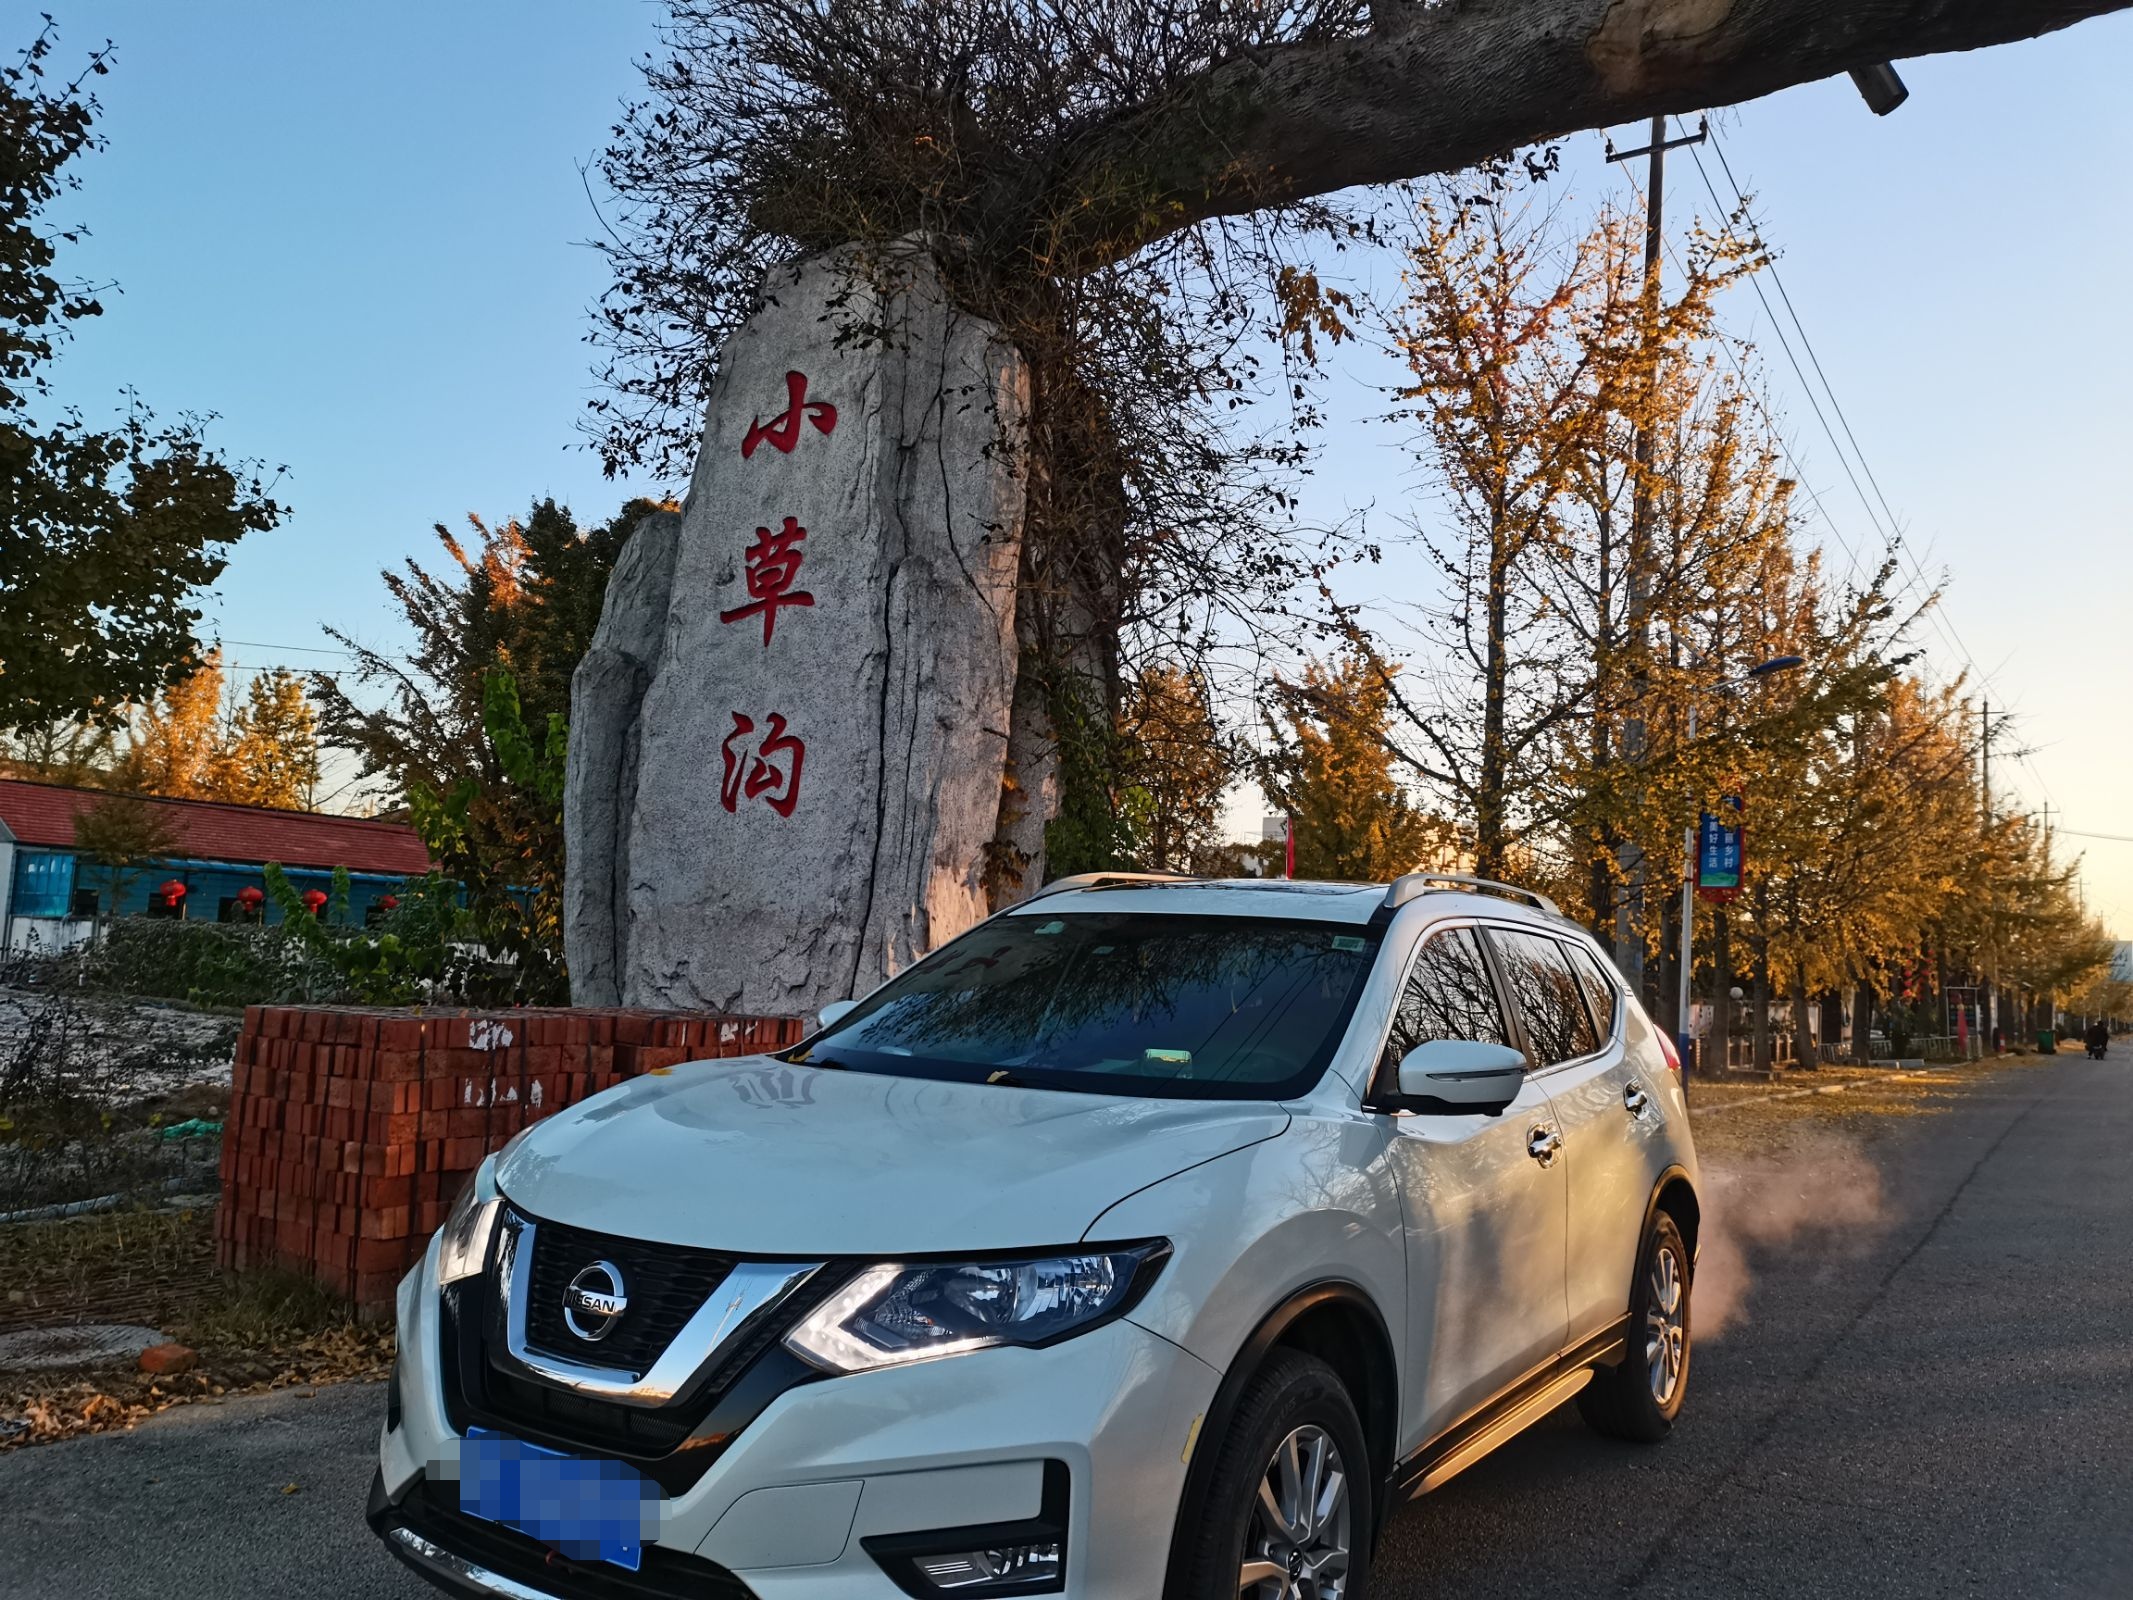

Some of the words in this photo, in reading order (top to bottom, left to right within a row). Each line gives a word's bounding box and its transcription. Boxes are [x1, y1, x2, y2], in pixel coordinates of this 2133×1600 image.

[720, 370, 837, 818] 小草沟
[565, 1290, 615, 1312] NISSAN
